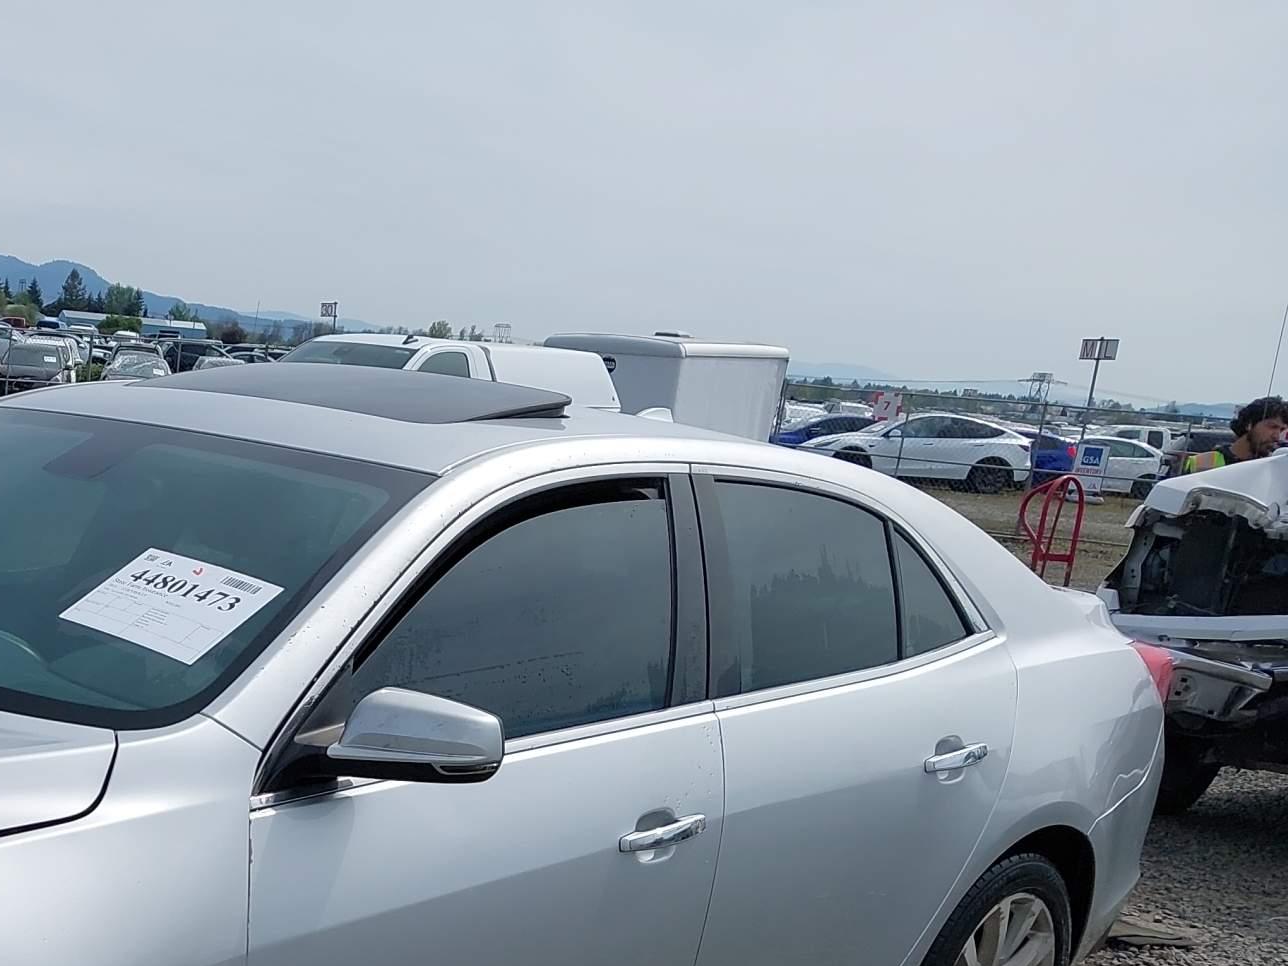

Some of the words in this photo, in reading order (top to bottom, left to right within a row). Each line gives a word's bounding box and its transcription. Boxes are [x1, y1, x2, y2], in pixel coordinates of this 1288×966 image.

[884, 400, 891, 411] 7
[1082, 455, 1100, 464] GSA
[130, 568, 242, 612] 44801473
